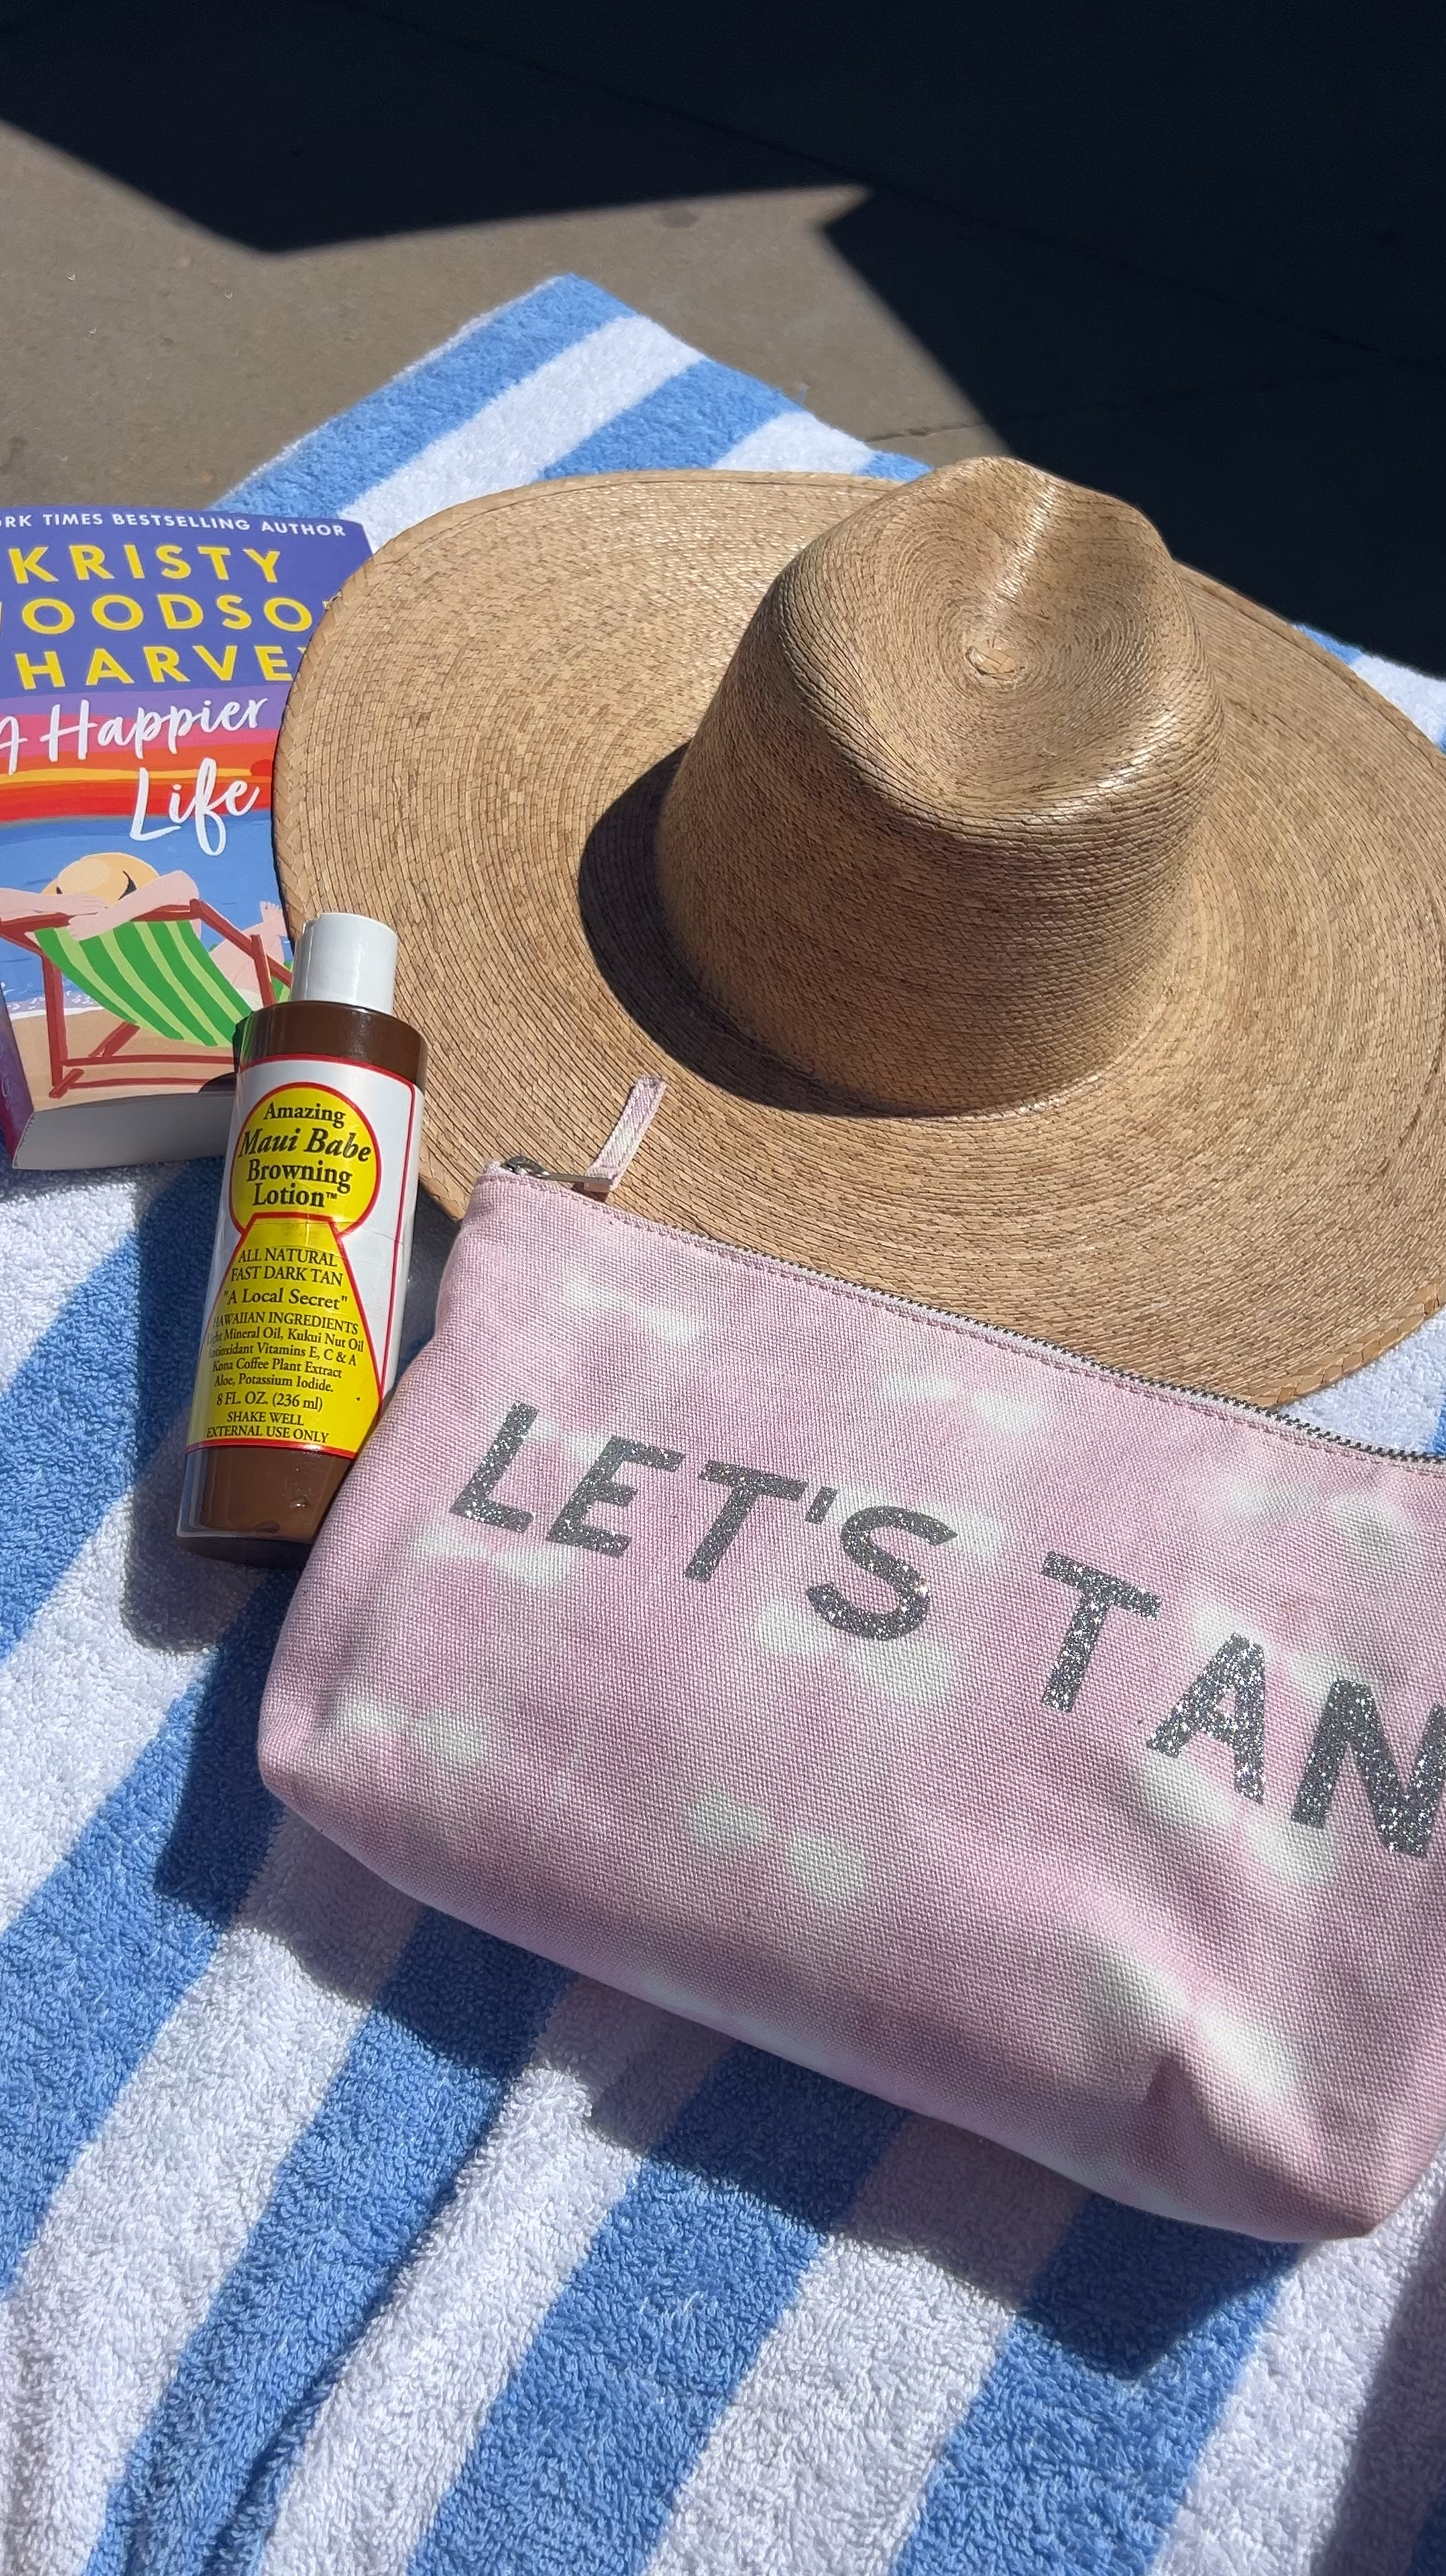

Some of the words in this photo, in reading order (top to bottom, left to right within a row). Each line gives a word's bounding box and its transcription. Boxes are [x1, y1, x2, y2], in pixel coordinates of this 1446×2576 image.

[42, 513, 103, 527] TIMES
[111, 513, 251, 531] BESTSELLING
[262, 521, 345, 537] AUTHOR
[8, 543, 280, 584] KRISTY
[0, 594, 331, 635] OODSO
[15, 645, 307, 690] HARVE
[0, 715, 28, 776] A
[40, 698, 268, 759] Happier
[130, 757, 261, 856] Life
[263, 1102, 346, 1129] Amazing
[237, 1128, 302, 1158] Maui
[303, 1128, 372, 1162] Babe
[246, 1159, 353, 1194] Browning
[238, 1248, 262, 1263] ALL
[265, 1248, 337, 1267] NATURAL
[231, 1266, 262, 1282] FAST
[264, 1265, 307, 1281] DARK
[311, 1268, 343, 1287] TAN
[241, 1287, 284, 1303] Local
[288, 1289, 348, 1309] Secret"
[213, 1311, 266, 1328] HAWAIIAN
[268, 1311, 359, 1335] INGREDIENTS
[224, 1326, 260, 1341] Mineral
[263, 1326, 284, 1341] Oil,
[288, 1328, 321, 1344] Kukui
[324, 1332, 346, 1348] Nut
[348, 1338, 364, 1352] Oil
[258, 1342, 307, 1356] Vitamins
[309, 1346, 320, 1360] E,
[323, 1348, 334, 1361] C
[336, 1351, 347, 1364] &
[348, 1354, 357, 1366] A
[212, 1360, 233, 1373] Kona
[236, 1356, 269, 1370] Coffee
[272, 1358, 302, 1372] Plant
[304, 1360, 343, 1379] Extract
[214, 1373, 236, 1387] Aloe,
[238, 1373, 293, 1387] Potassium
[296, 1375, 334, 1393] Iodide.
[216, 1393, 223, 1406] 8
[225, 1391, 241, 1405] FL.
[245, 1391, 268, 1405] OZ.
[272, 1392, 301, 1407] (236
[302, 1396, 323, 1413] ml)
[227, 1411, 266, 1423] SHAKE
[269, 1411, 304, 1426] WELL
[207, 1425, 264, 1438] EXTERNAL
[266, 1426, 290, 1439] USE
[293, 1428, 330, 1444] ONLY
[449, 1399, 958, 1642] LET'S
[1041, 1550, 1446, 1858] TAN
